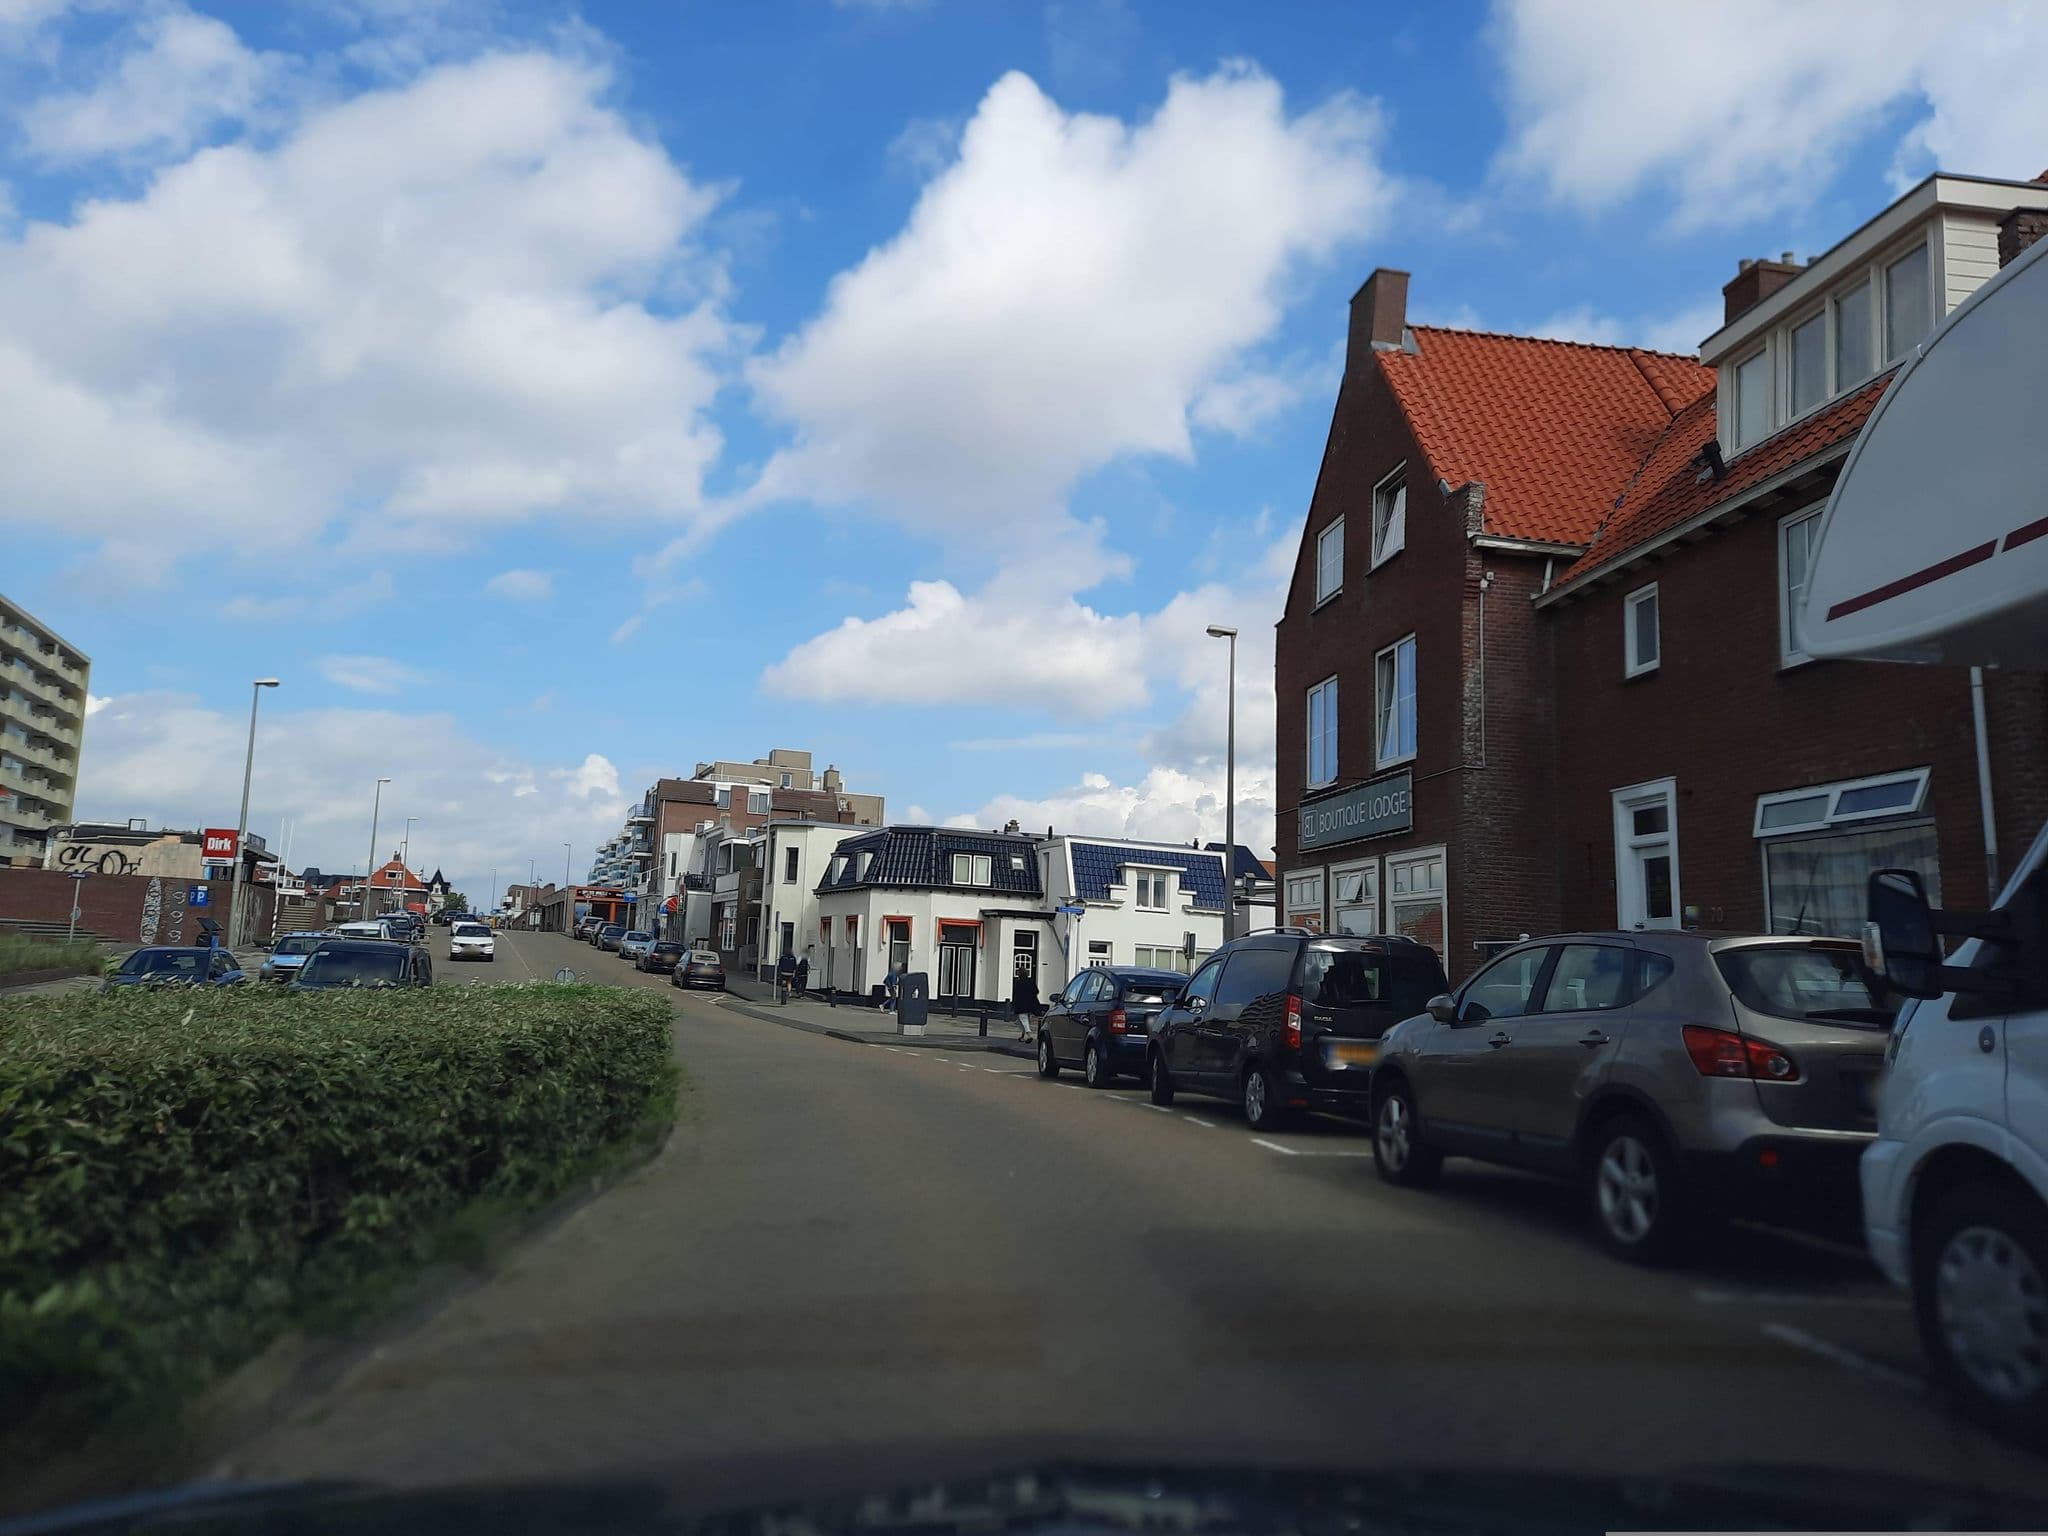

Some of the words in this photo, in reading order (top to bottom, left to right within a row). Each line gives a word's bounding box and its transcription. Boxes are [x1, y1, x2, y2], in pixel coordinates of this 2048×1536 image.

[1319, 802, 1366, 833] BOUTIQUE
[1369, 790, 1407, 820] LODGE
[207, 837, 231, 851] Dirk
[197, 891, 205, 902] P
